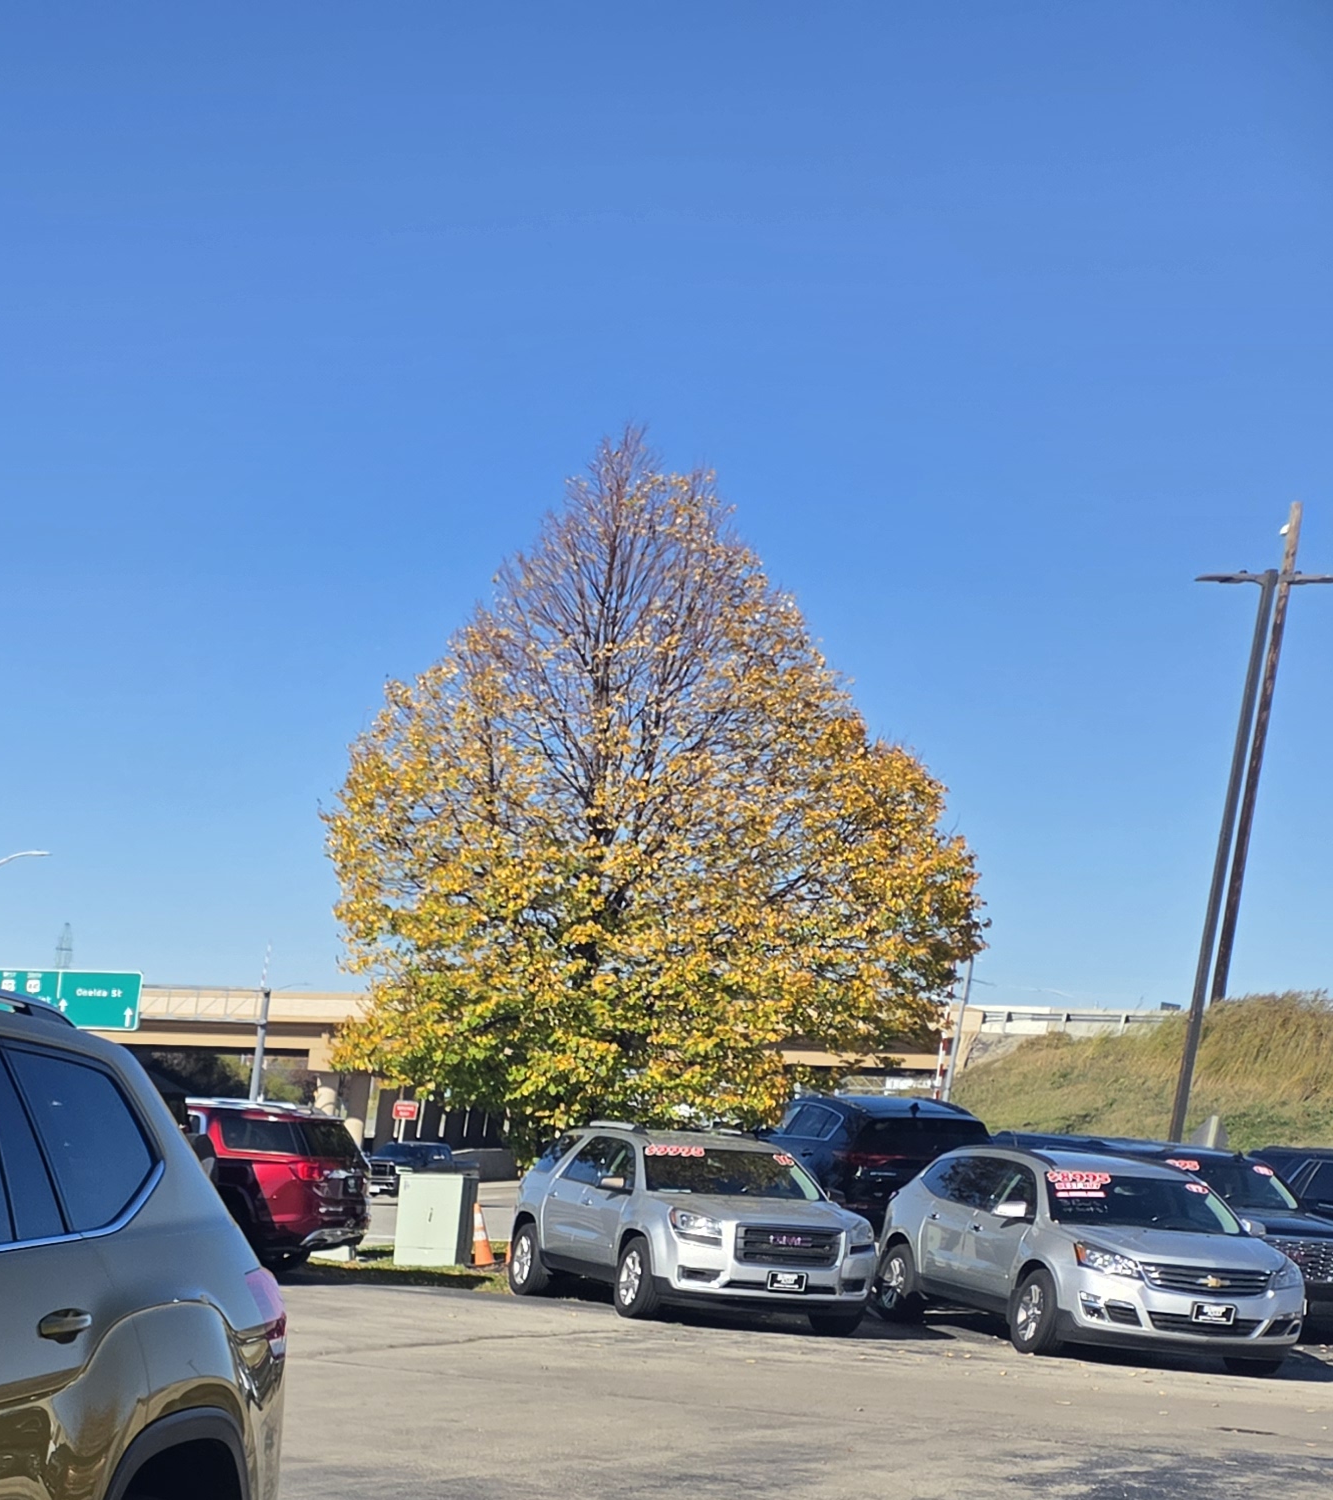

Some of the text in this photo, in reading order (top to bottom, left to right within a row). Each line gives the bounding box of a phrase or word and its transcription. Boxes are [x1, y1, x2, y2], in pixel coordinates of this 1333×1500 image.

[76, 987, 123, 998] Oneida St
[1047, 1171, 1111, 1184] $8995
